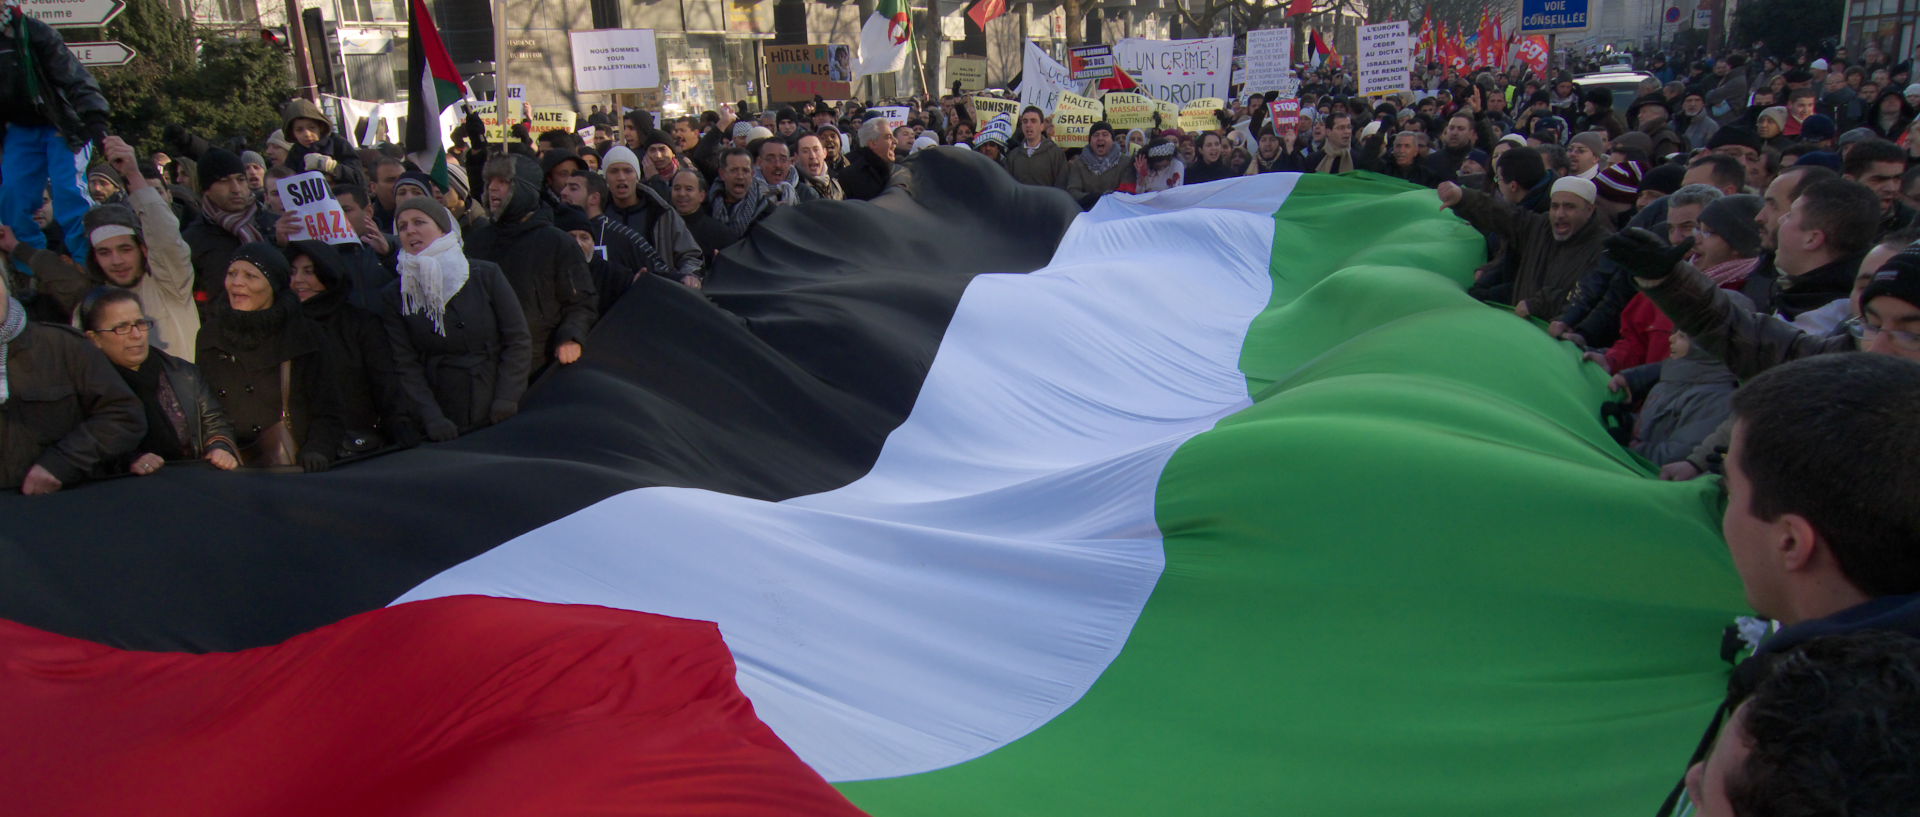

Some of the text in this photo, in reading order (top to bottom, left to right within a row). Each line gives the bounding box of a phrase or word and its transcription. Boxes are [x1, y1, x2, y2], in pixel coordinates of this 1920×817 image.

[1544, 0, 1566, 11] VOIE
[1523, 13, 1585, 26] CONSEILLÉE
[1367, 24, 1400, 32] L'EUROPE
[770, 47, 810, 62] HITLER
[1094, 57, 1105, 65] DES
[1135, 51, 1155, 71] UN
[1366, 59, 1403, 67] ISRAELIEN
[598, 63, 647, 71] PALESTINIENS
[1368, 75, 1402, 83] COMPLICE
[1160, 80, 1206, 104] DROIT
[1063, 93, 1095, 110] HALTE
[1111, 95, 1142, 104] HALTE
[1184, 100, 1213, 109] HALTE
[975, 99, 1017, 114] SIONISME
[1109, 105, 1150, 113] MASSACRE
[1275, 102, 1298, 112] STOP
[1057, 114, 1096, 124] ISRAEL
